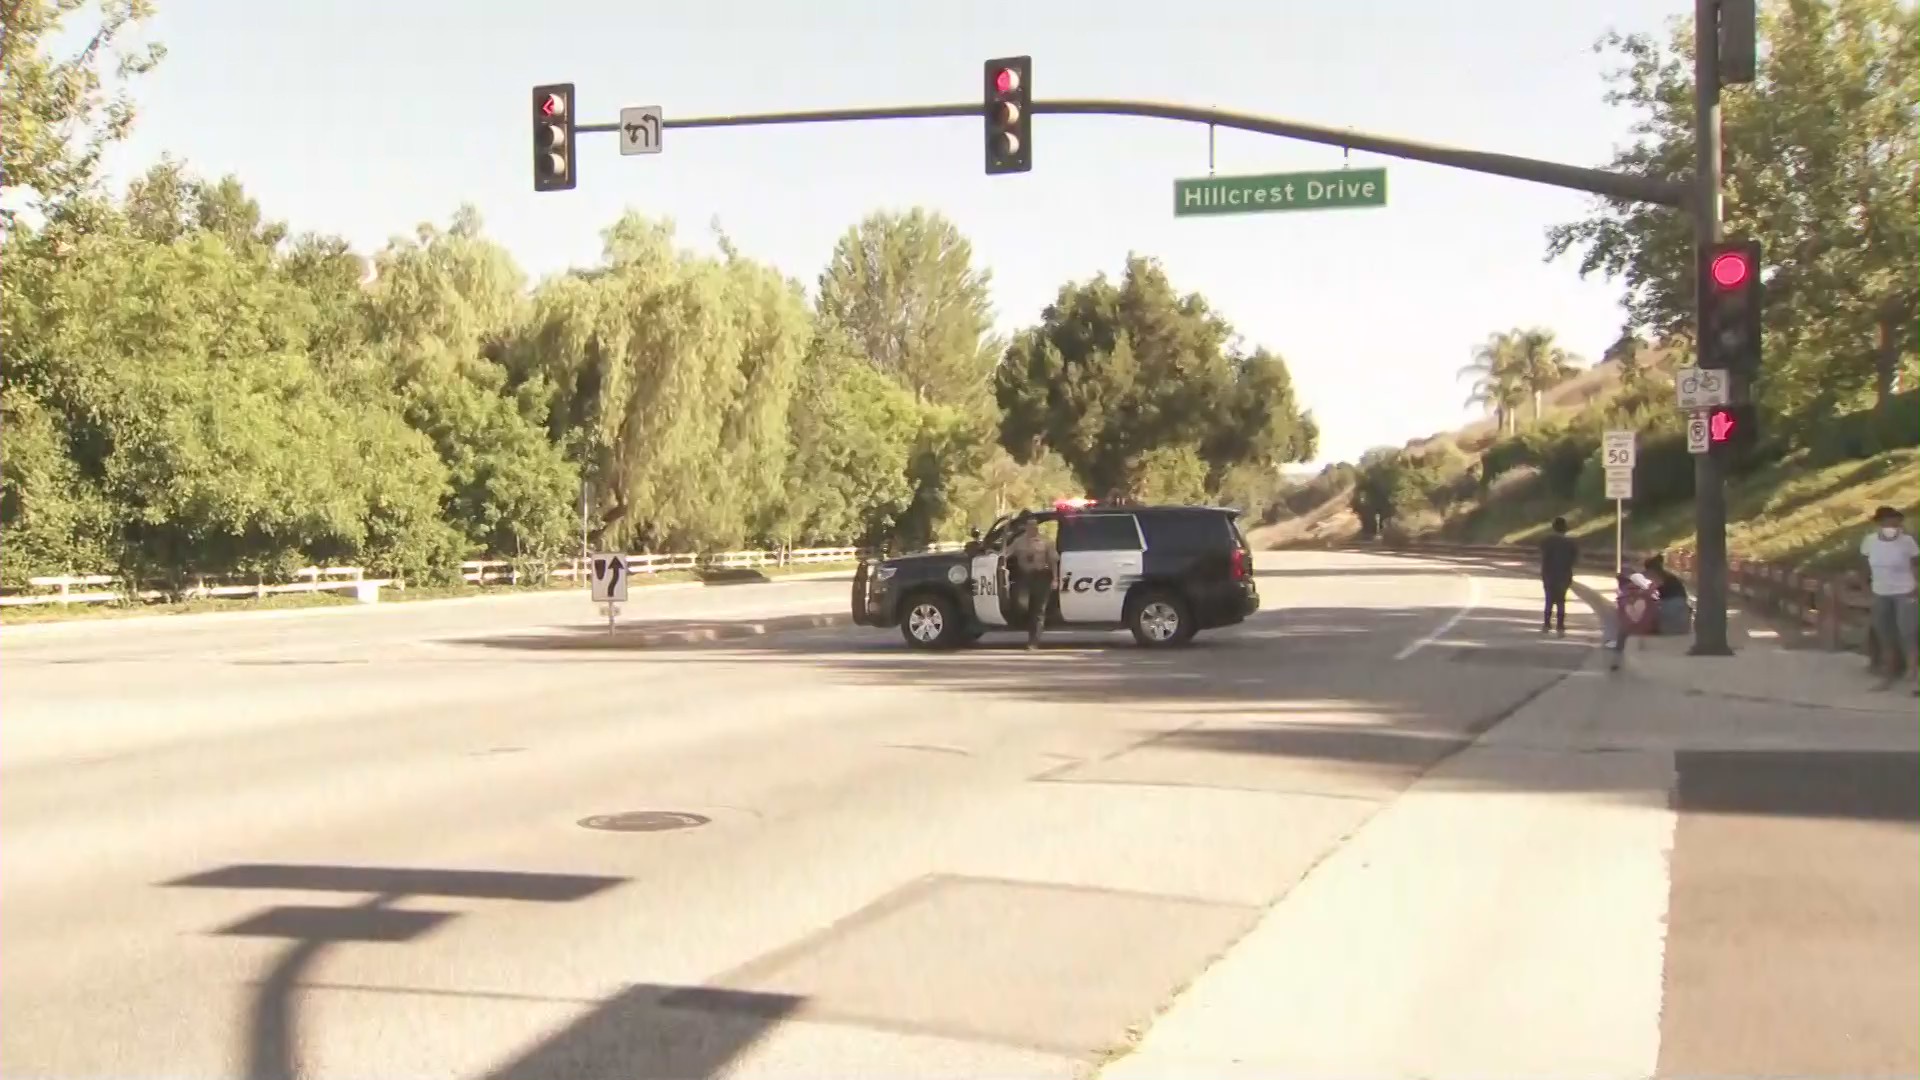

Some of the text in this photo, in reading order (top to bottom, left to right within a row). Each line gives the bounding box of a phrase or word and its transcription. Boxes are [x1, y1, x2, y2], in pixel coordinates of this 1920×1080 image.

[1184, 179, 1375, 206] Hillcrest Drive
[1608, 449, 1629, 464] 50
